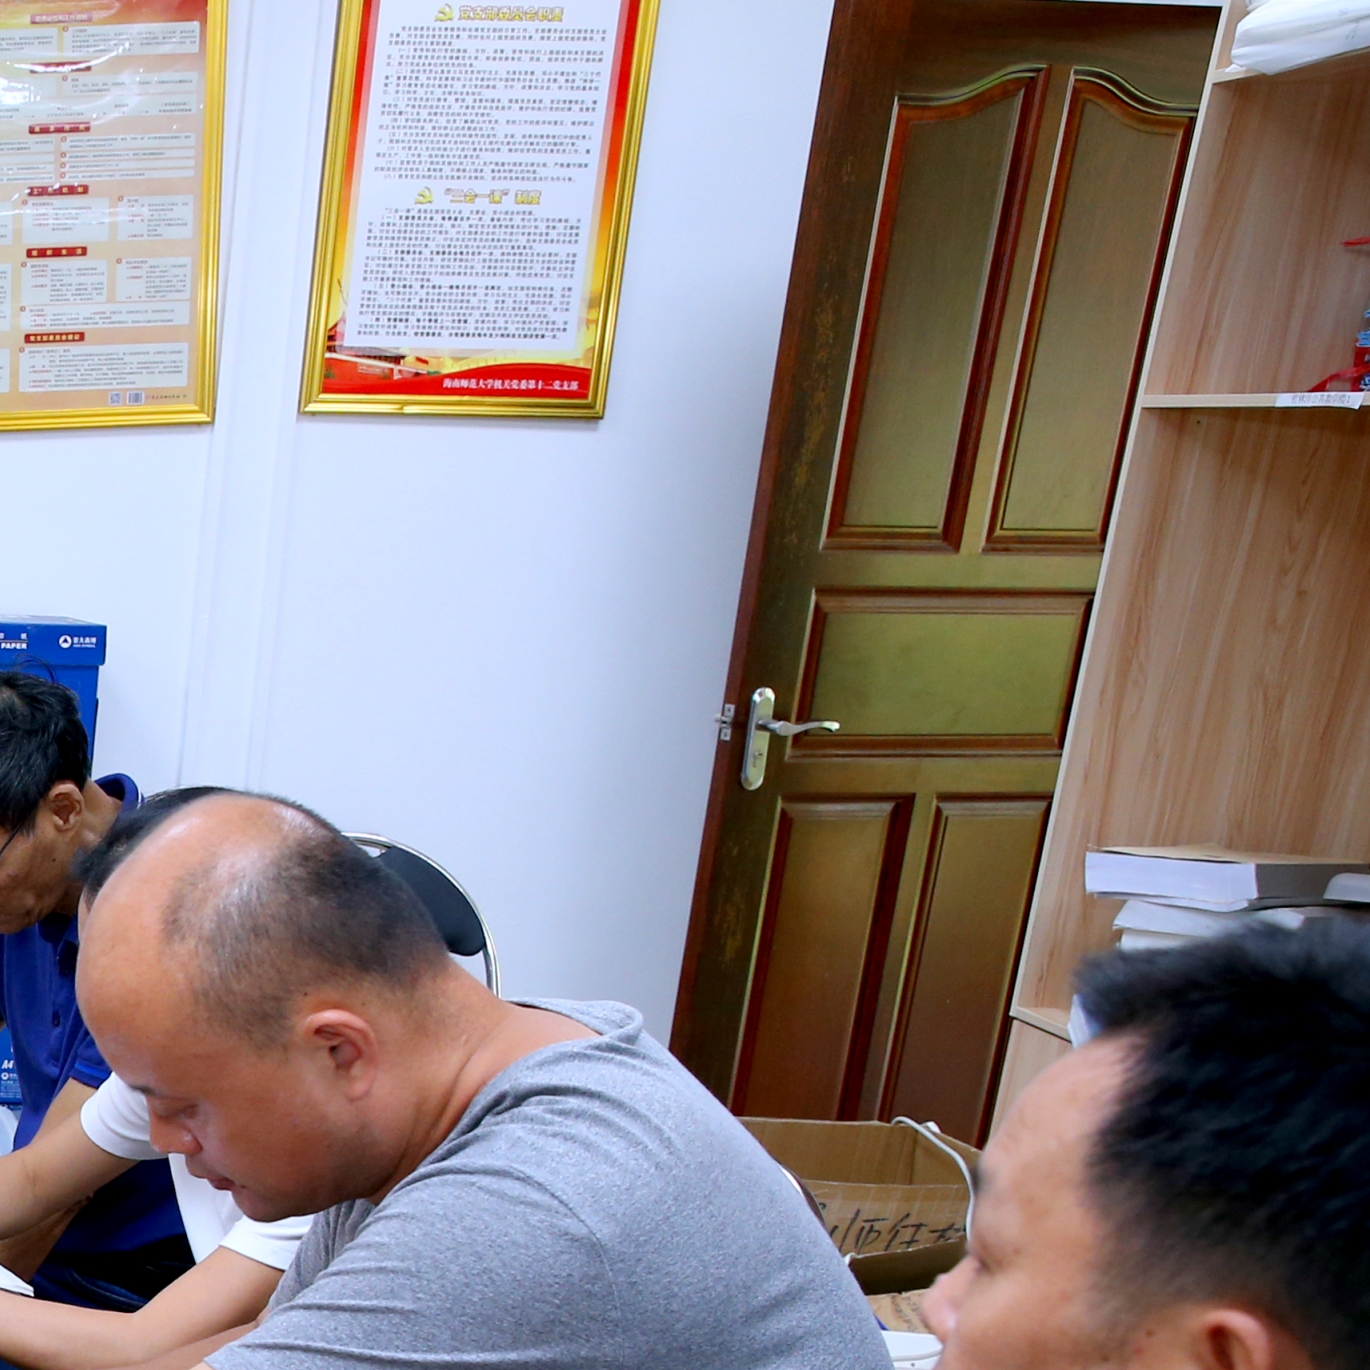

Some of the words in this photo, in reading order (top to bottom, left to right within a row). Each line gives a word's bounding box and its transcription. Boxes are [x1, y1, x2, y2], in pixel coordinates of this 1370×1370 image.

[458, 6, 564, 22] 党支部委员会职责
[442, 378, 579, 390] 海南师范大学机关党委第十二党支部
